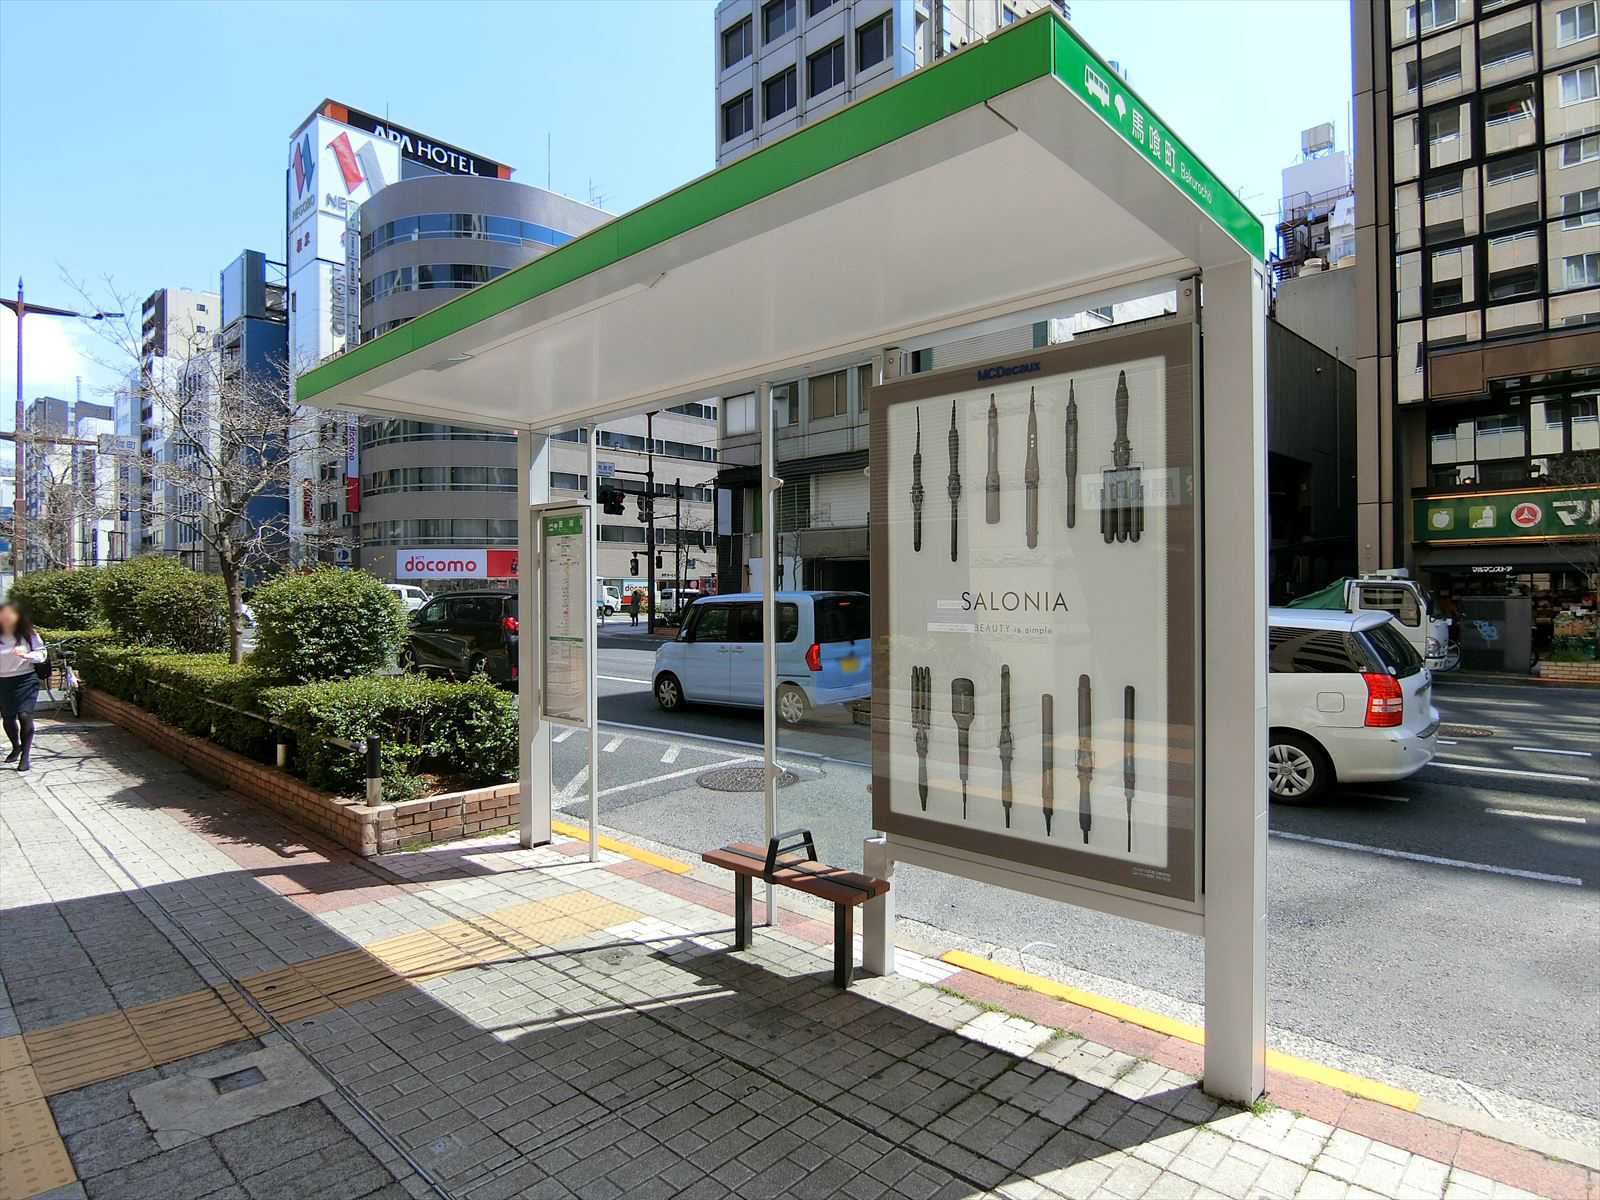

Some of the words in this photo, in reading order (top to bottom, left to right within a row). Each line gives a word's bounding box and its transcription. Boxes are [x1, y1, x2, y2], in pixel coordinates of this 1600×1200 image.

[374, 124, 414, 153] APA
[417, 140, 479, 176] HOTEL
[1132, 108, 1175, 172] 馬喰町
[978, 362, 1040, 382] MCDecaux
[405, 556, 477, 572] docomo
[961, 591, 1069, 612] SALONIA
[974, 624, 1010, 633] BEAUTY
[1025, 626, 1052, 635] simple
